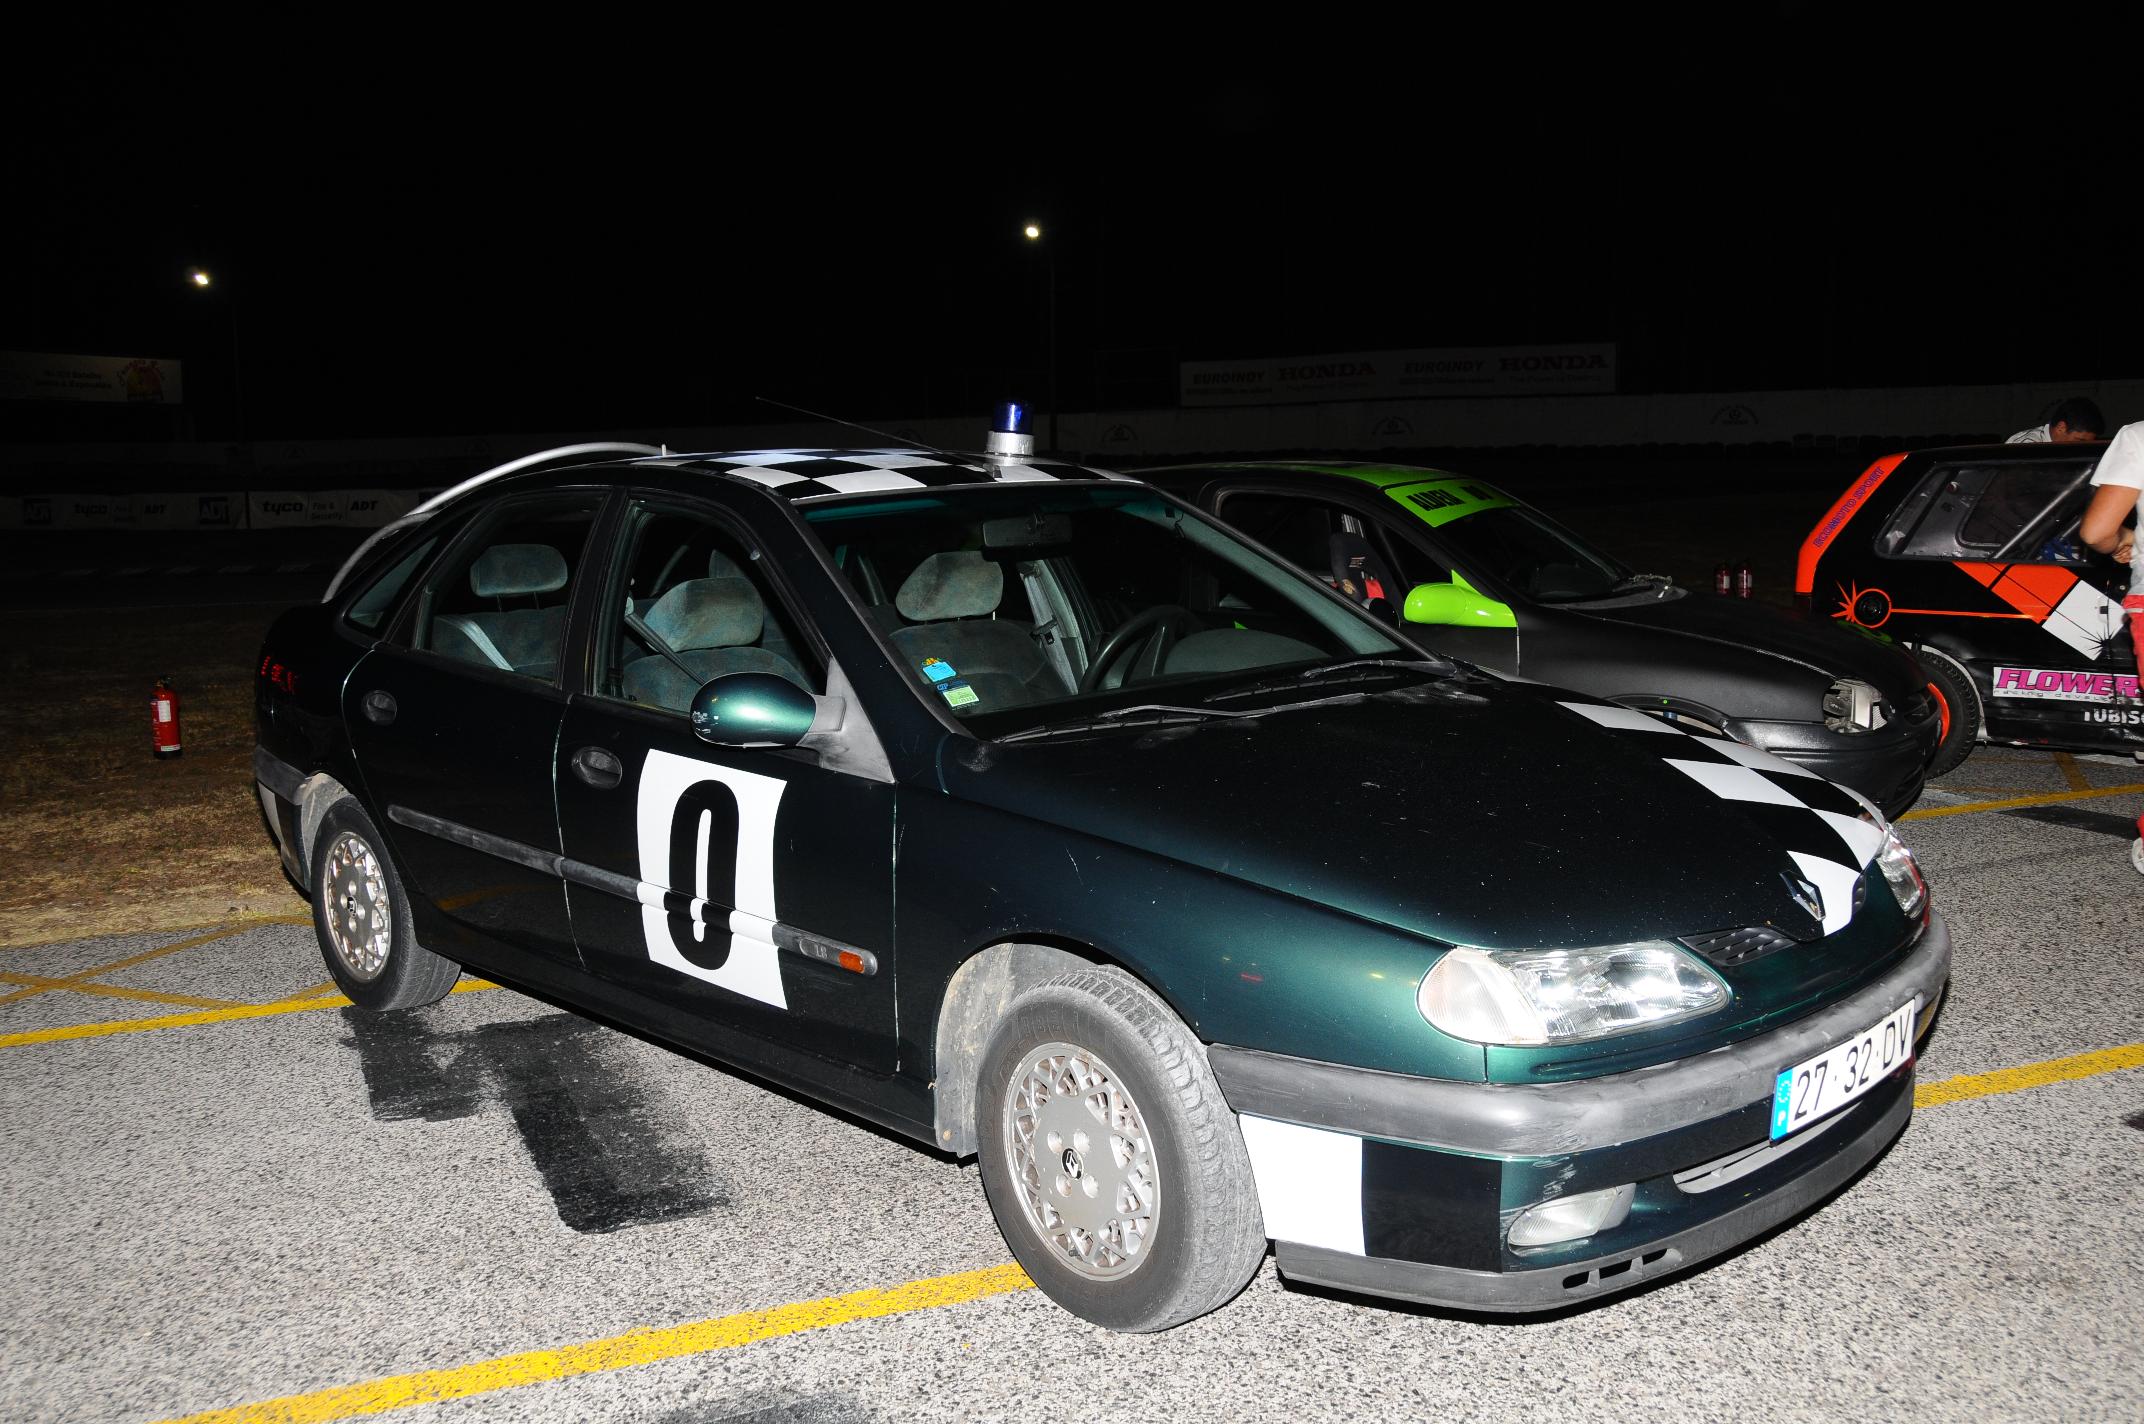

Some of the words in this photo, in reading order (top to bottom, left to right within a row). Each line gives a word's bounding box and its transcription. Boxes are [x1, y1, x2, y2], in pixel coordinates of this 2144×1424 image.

[1278, 361, 1377, 381] HONDA
[1499, 354, 1608, 371] HONDA
[262, 500, 304, 515] tyco
[350, 500, 378, 511] ADT
[664, 779, 739, 971] 0
